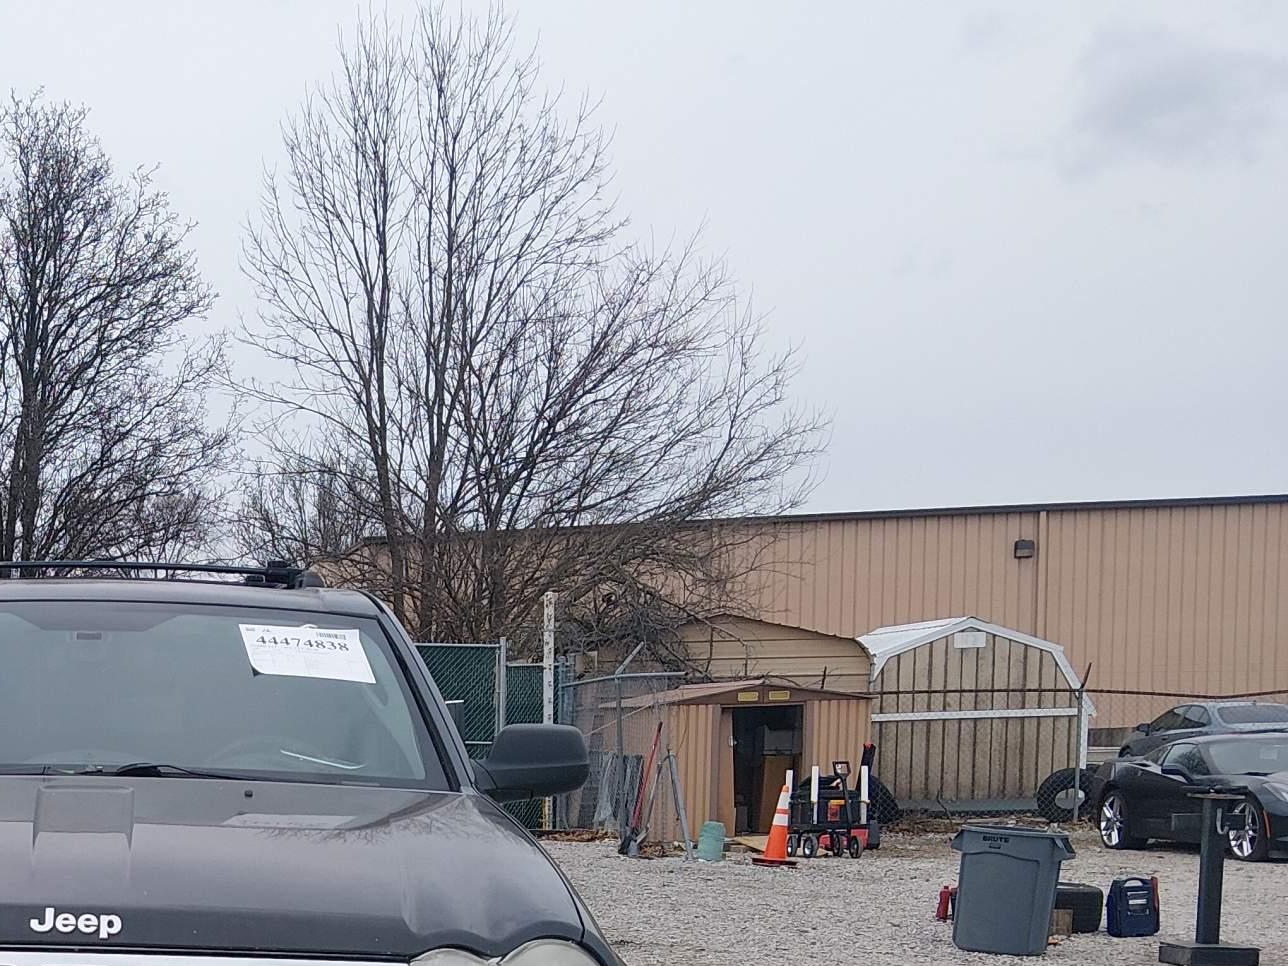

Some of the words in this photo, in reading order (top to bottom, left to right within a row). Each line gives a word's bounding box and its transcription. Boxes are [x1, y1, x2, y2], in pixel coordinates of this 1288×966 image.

[255, 635, 350, 652] 44474838
[982, 835, 1010, 843] BRUTE
[29, 907, 122, 939] Jeep
